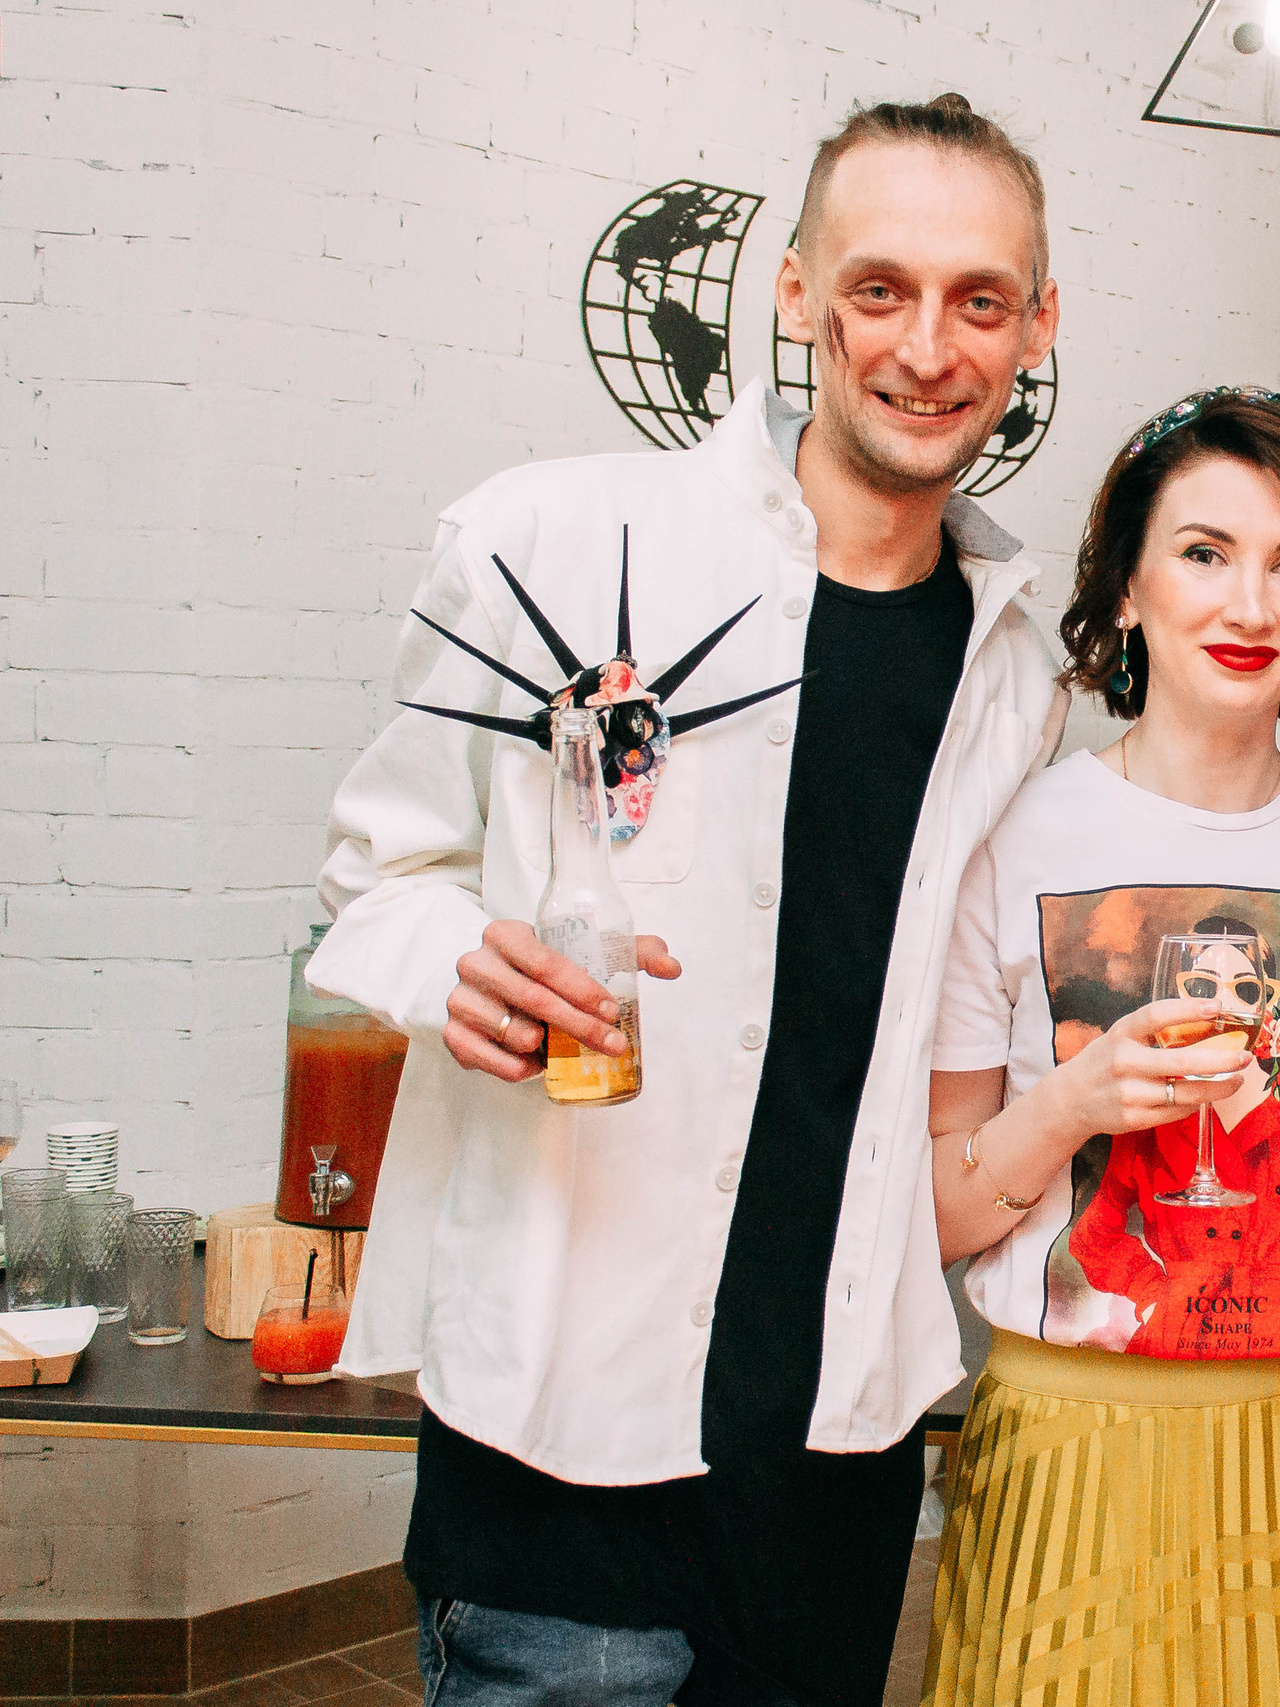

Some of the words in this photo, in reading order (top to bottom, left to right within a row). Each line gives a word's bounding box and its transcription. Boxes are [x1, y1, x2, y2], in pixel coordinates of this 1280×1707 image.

[1187, 1296, 1268, 1314] ICONIC
[1200, 1316, 1253, 1334] SHAPE
[1177, 1337, 1210, 1350] Since
[1215, 1338, 1241, 1350] May
